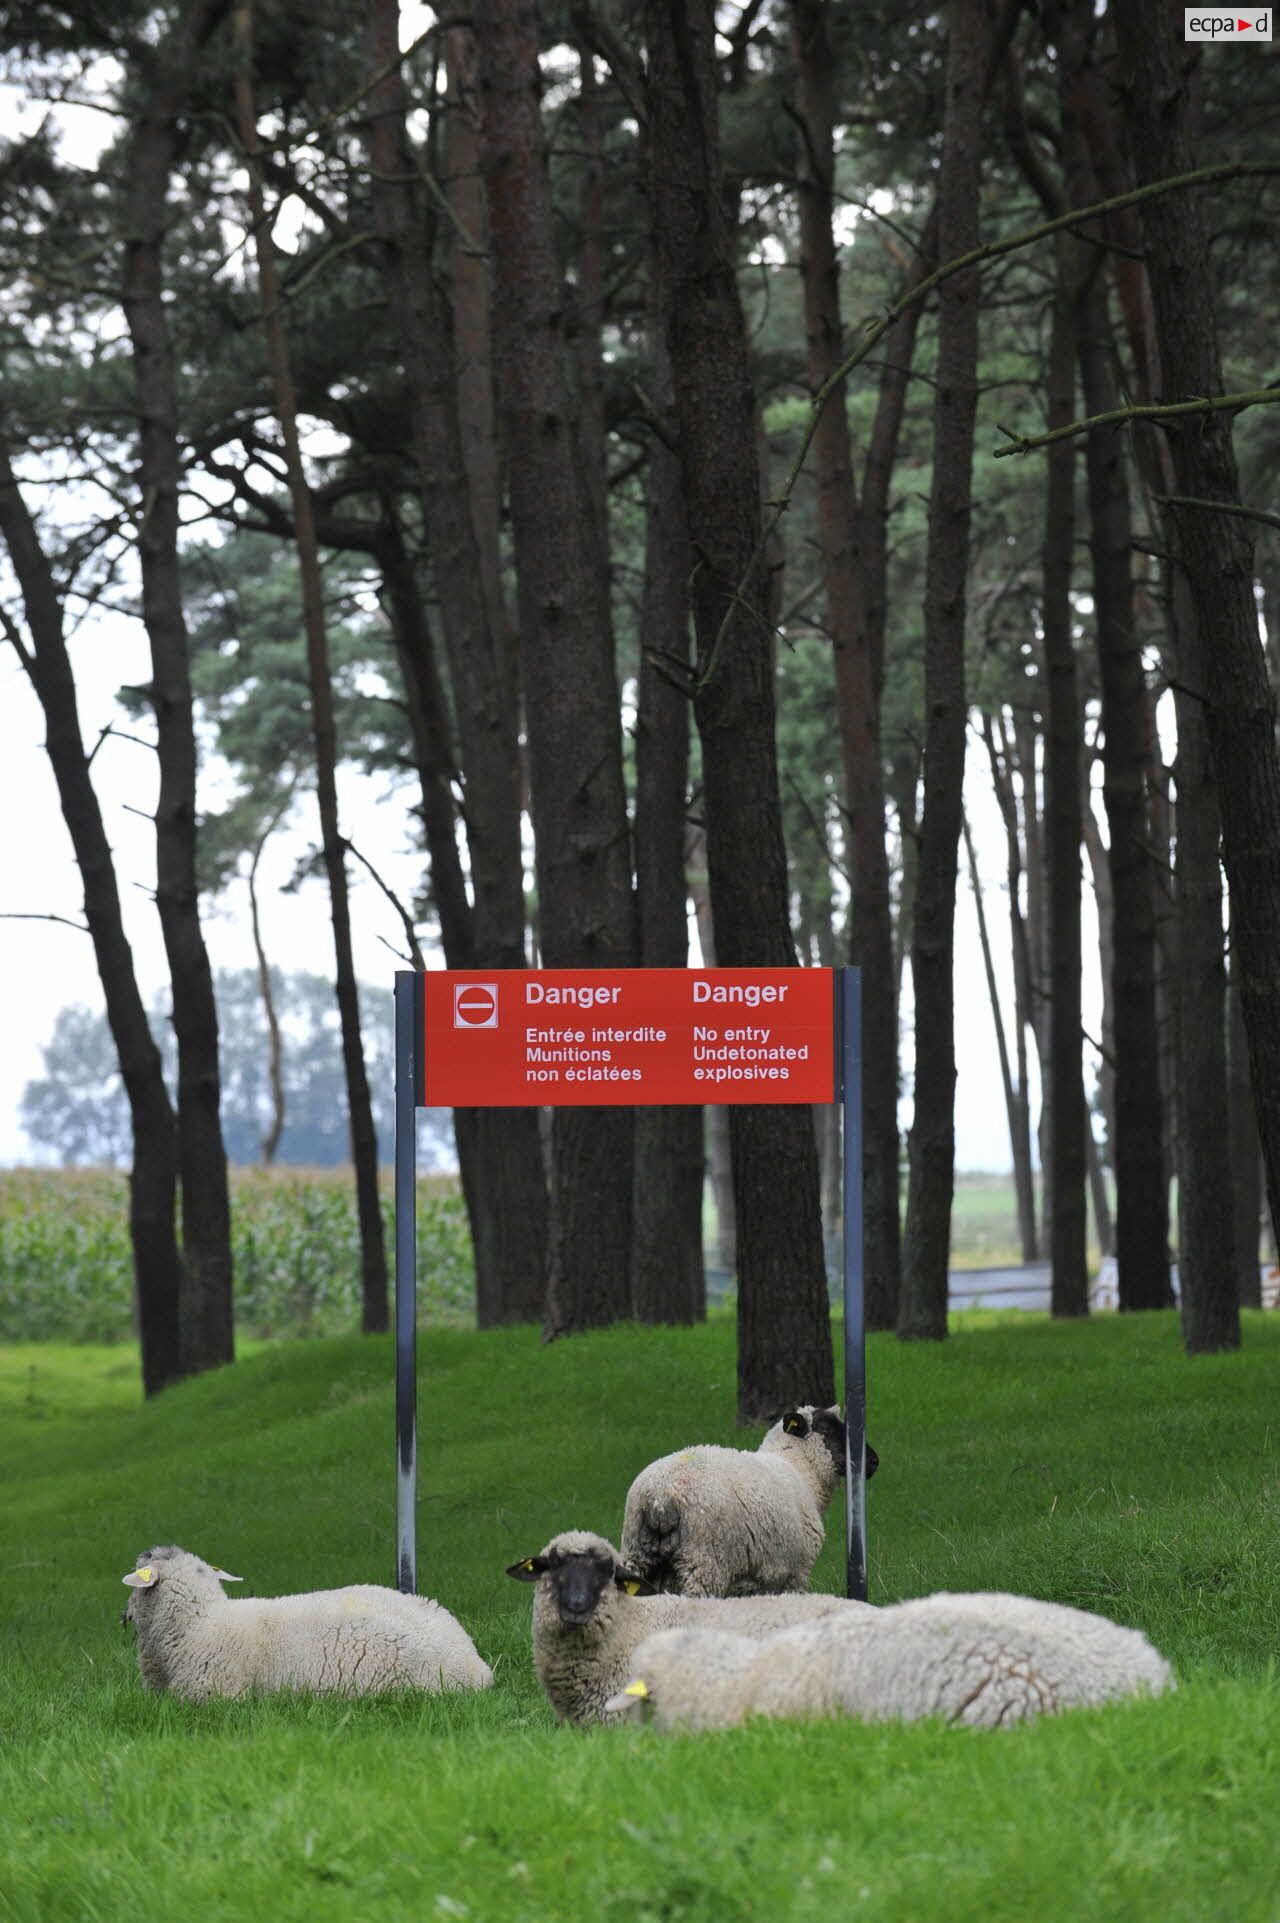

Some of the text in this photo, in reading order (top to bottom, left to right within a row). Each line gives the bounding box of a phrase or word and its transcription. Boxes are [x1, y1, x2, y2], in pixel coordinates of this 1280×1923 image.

[525, 982, 622, 1009] Danger
[693, 981, 789, 1008] Danger
[526, 1026, 667, 1043] Entrée interdite
[693, 1026, 771, 1044] No entry
[526, 1046, 612, 1063] Munitions
[693, 1044, 809, 1061] Undetonated
[526, 1065, 642, 1082] non éclatées
[693, 1064, 790, 1084] explosives
